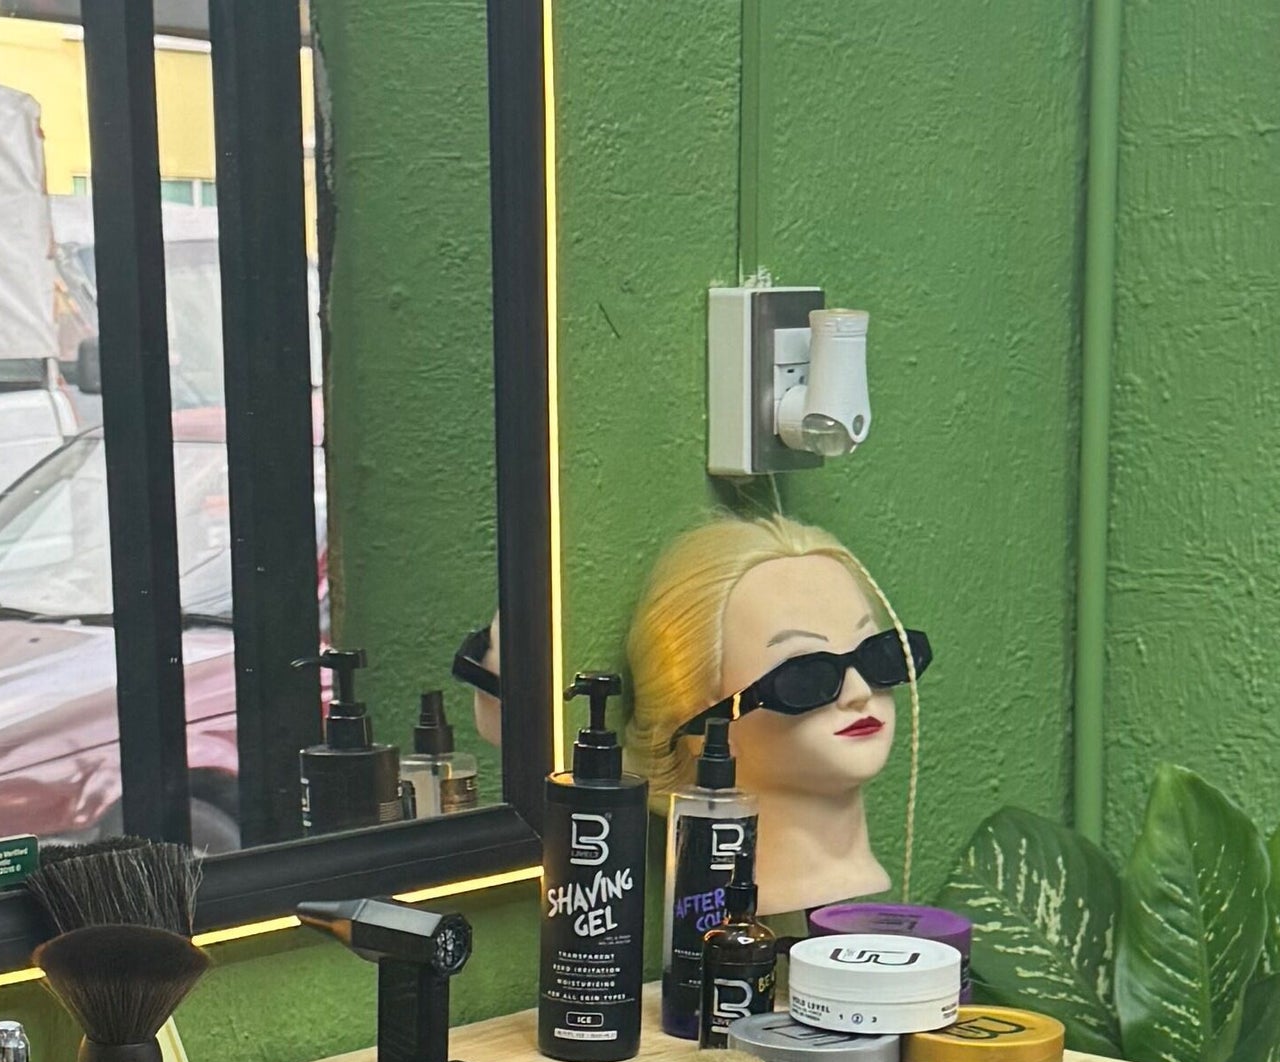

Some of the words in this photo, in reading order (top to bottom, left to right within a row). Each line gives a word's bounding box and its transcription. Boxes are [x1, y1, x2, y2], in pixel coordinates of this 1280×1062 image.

[547, 867, 633, 918] SHAVING
[675, 887, 726, 919] AFTER
[574, 909, 618, 937] GEL
[577, 1016, 592, 1024] ICE
